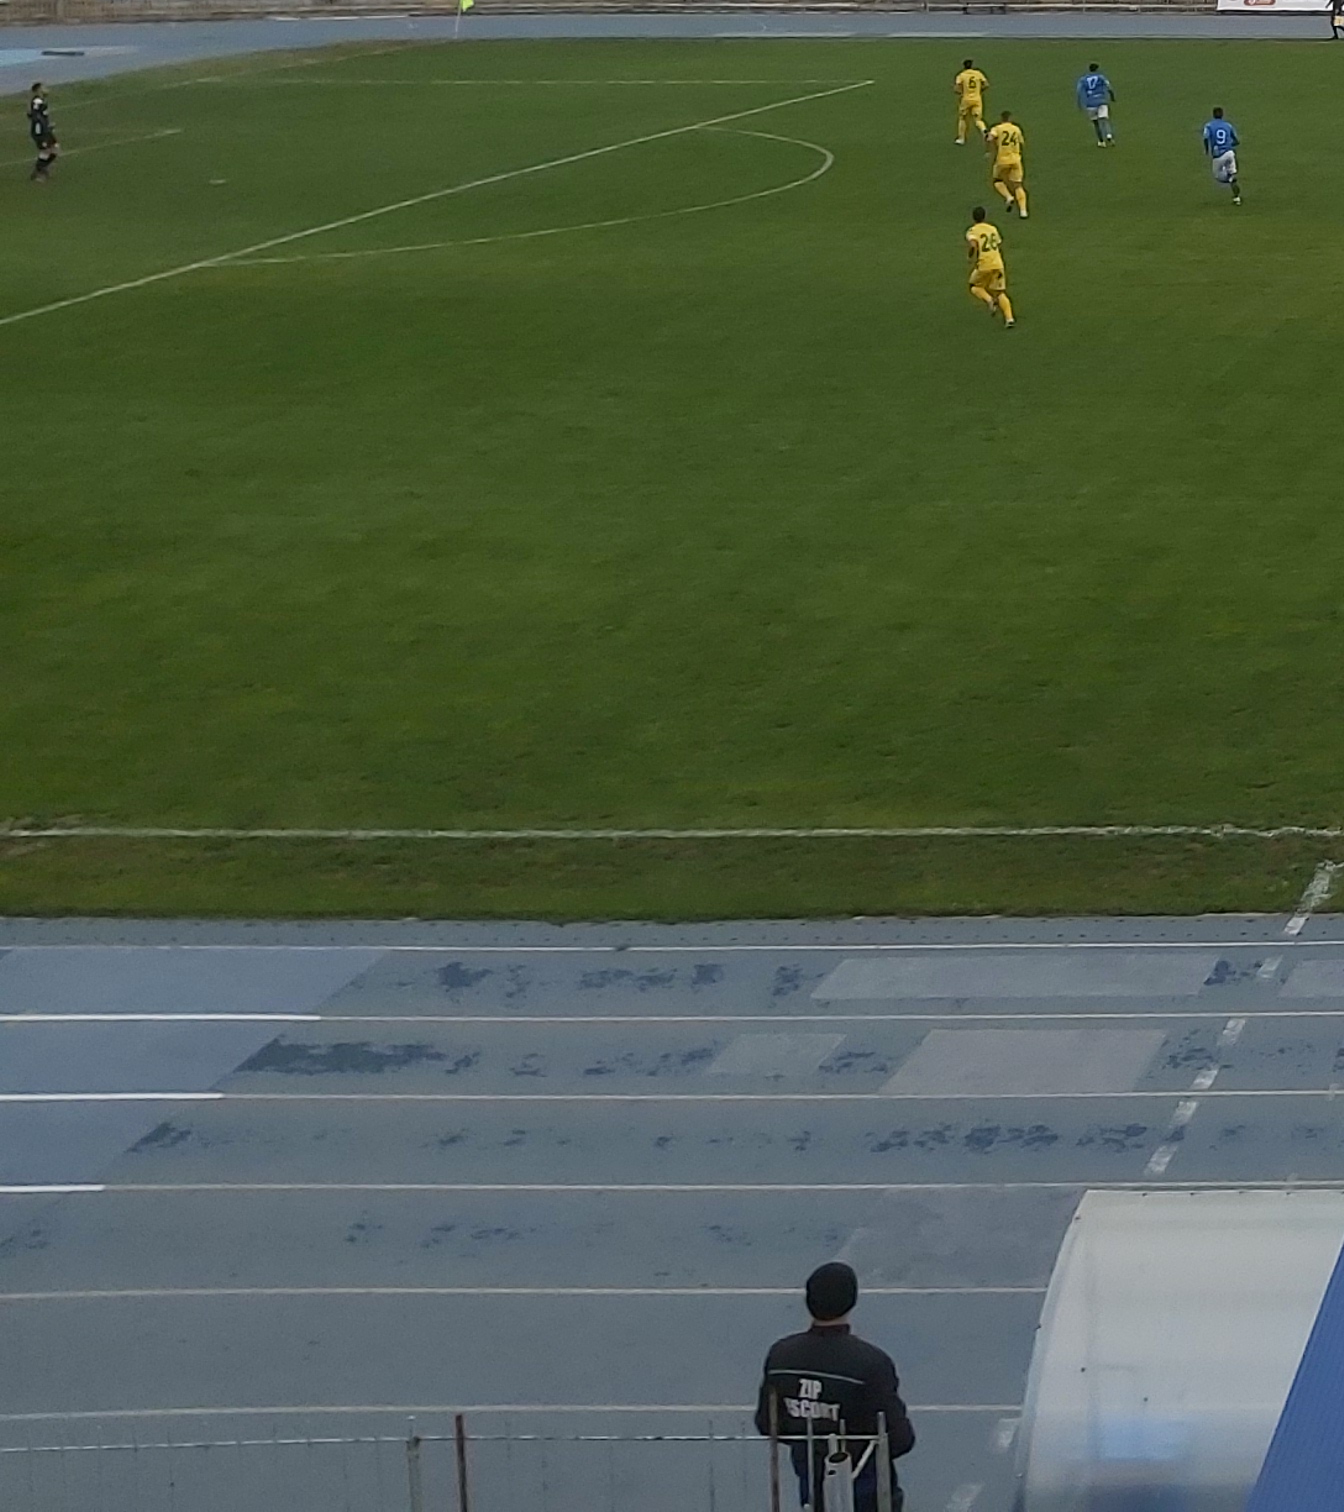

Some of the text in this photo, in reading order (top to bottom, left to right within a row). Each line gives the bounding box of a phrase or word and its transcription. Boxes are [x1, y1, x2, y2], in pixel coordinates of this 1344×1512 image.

[1001, 130, 1018, 147] 24
[1216, 128, 1227, 145] 9
[798, 1377, 823, 1400] ZIP
